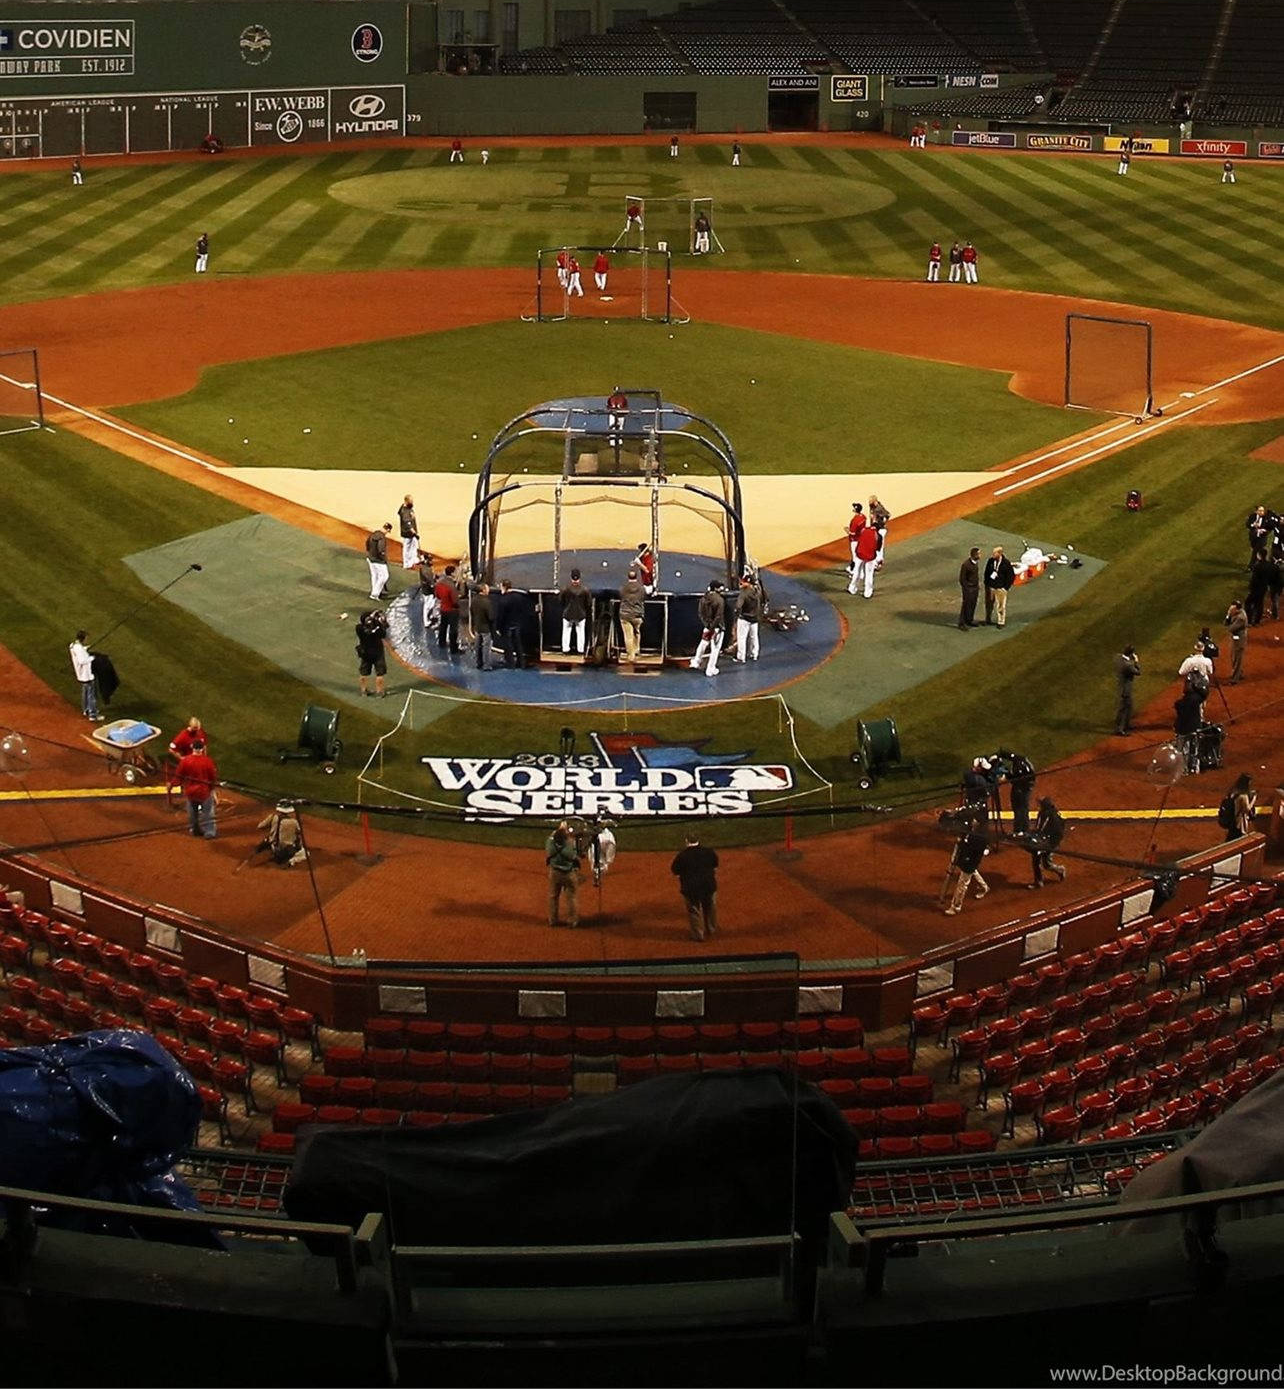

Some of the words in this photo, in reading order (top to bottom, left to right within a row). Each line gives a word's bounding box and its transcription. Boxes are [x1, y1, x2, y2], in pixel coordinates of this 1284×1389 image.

[18, 29, 130, 49] COVIDIEN
[34, 60, 60, 73] PARK
[82, 59, 102, 72] EST.
[105, 59, 125, 71] 1912
[836, 80, 862, 88] GIANT
[952, 76, 976, 86] NESN
[835, 88, 863, 97] GLASS
[255, 98, 282, 111] F.W.
[283, 96, 325, 110] WEBB
[254, 121, 273, 131] Since
[308, 118, 325, 128] 1866
[336, 119, 398, 133] HYUNDAI
[969, 132, 1000, 145] jetBlue
[1030, 136, 1068, 146] GRANITE
[1069, 136, 1089, 148] CITY
[1196, 142, 1232, 154] xfinity
[516, 754, 600, 767] 2013
[421, 757, 697, 791] WORLD
[465, 790, 754, 818] SERIES
